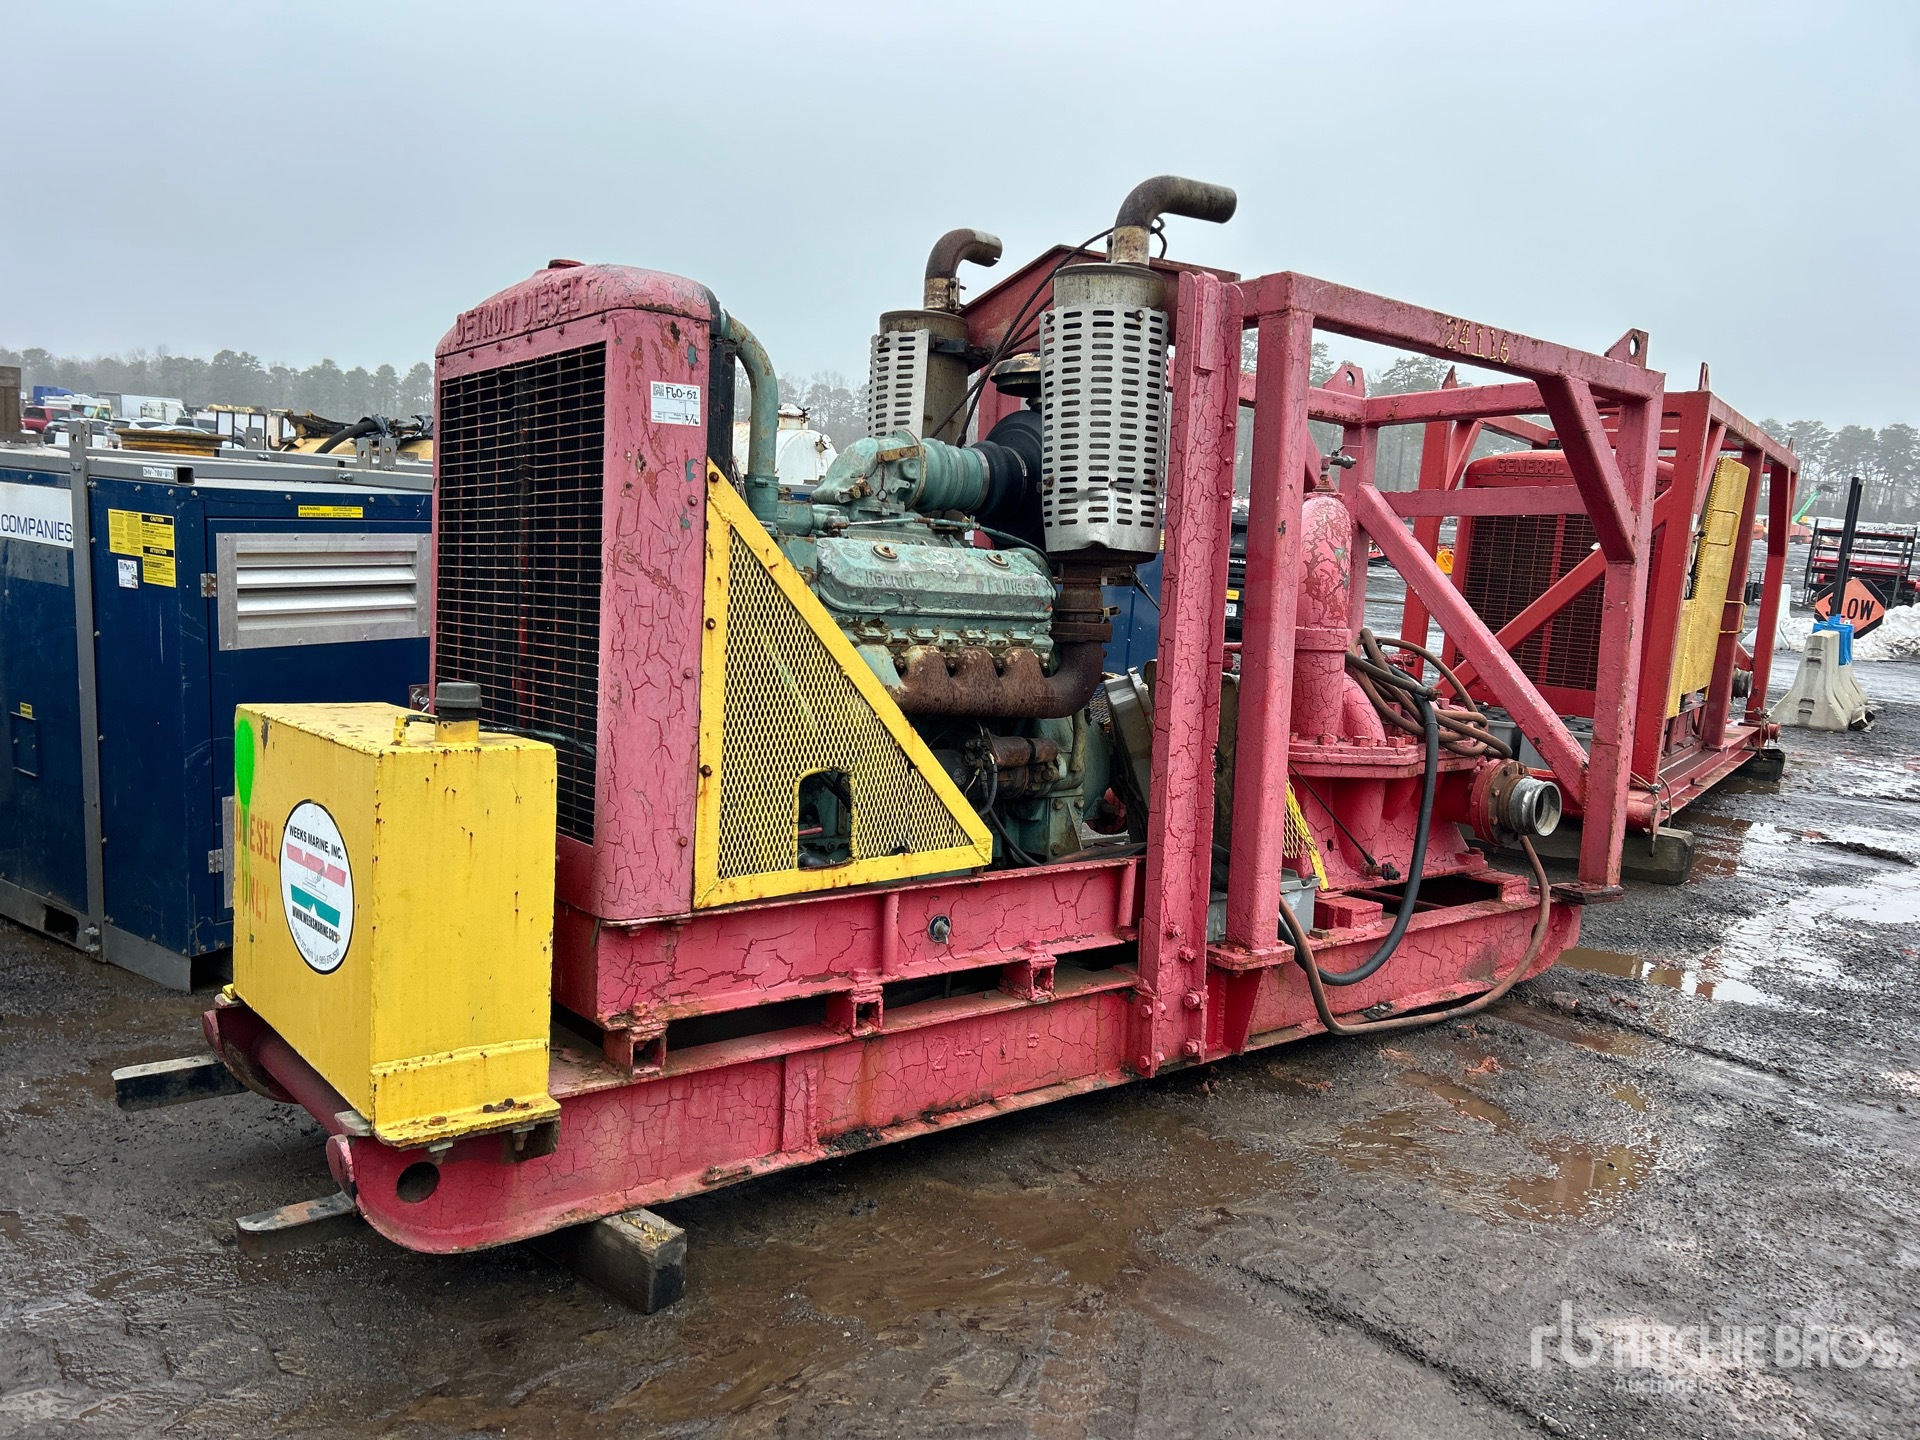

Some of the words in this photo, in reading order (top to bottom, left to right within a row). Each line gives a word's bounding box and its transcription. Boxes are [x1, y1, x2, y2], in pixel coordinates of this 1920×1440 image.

[456, 298, 517, 346] DETROIT
[523, 276, 580, 328] DIESEL
[1445, 317, 1509, 363] 24116
[1495, 458, 1564, 475] GENERAL
[1, 514, 73, 542] COMPANIES
[289, 824, 307, 843] WEEKS
[308, 833, 330, 857] MARINE,
[331, 843, 343, 860] INC.
